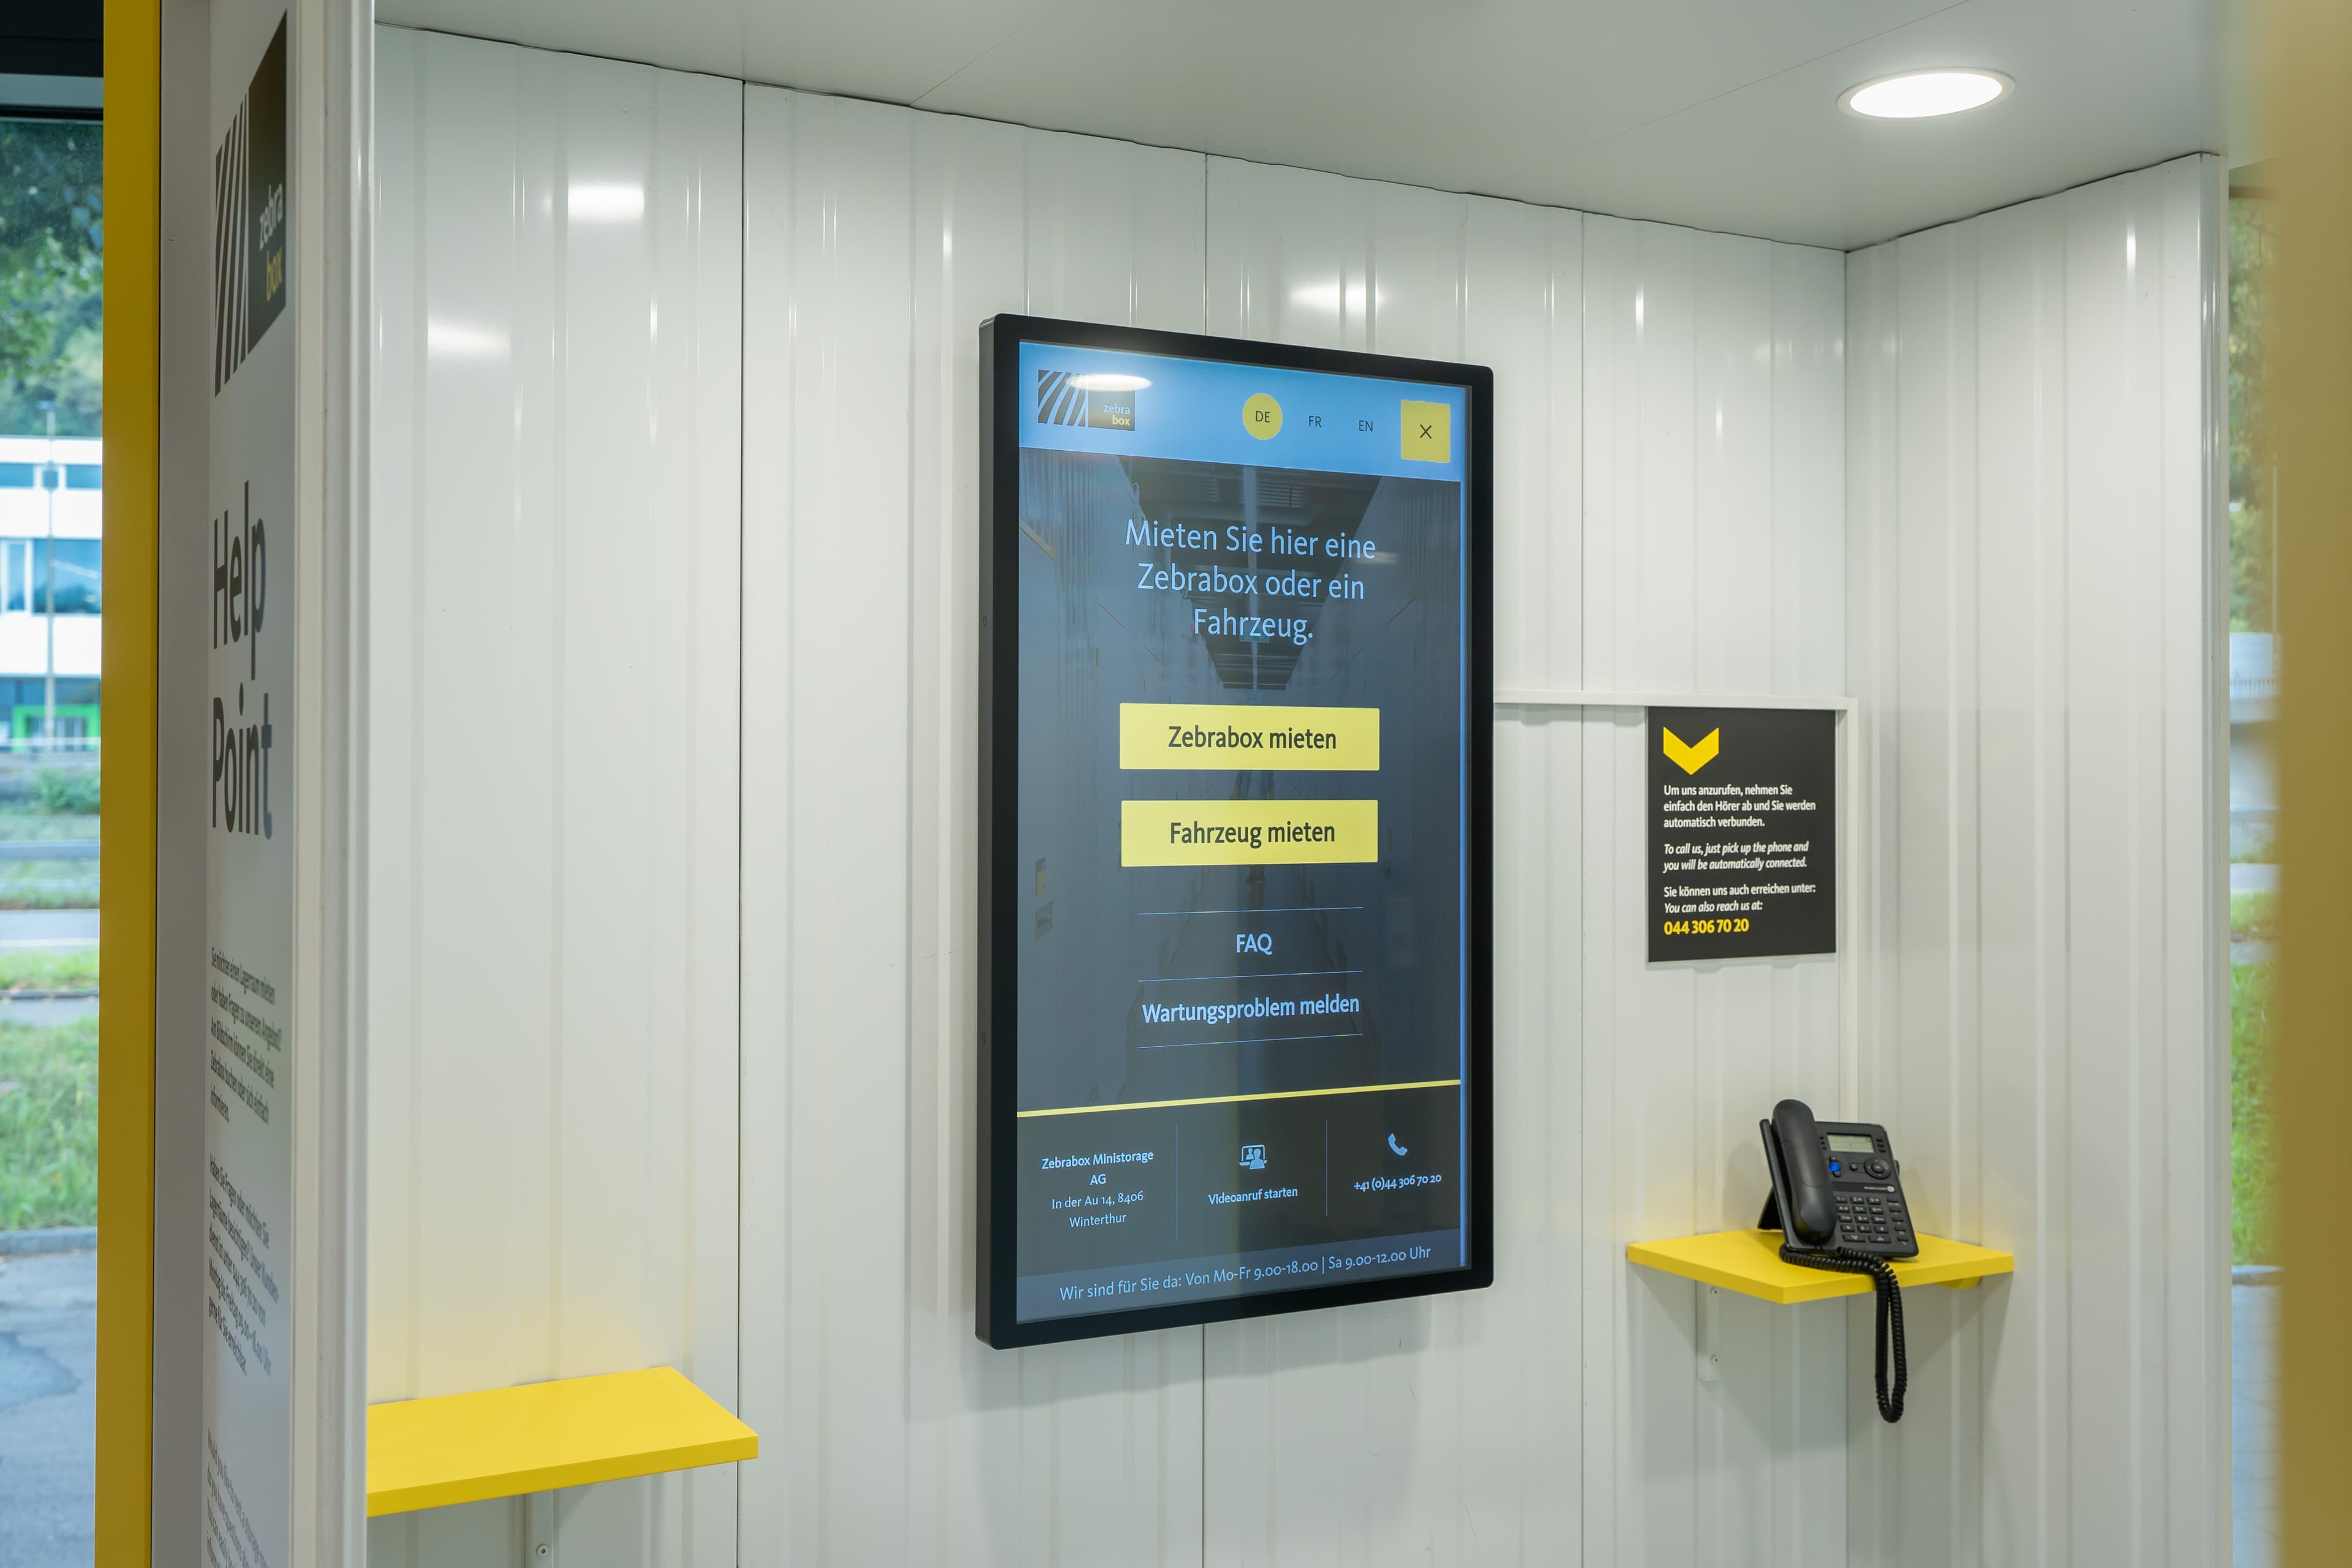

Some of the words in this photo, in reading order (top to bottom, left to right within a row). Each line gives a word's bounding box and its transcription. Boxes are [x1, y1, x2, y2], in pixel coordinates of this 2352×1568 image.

[259, 181, 283, 251] zebra
[266, 247, 282, 301] box
[1103, 403, 1131, 415] zebra
[1112, 415, 1130, 427] box
[1255, 410, 1270, 423] DE
[1309, 415, 1322, 428] FR
[1359, 420, 1373, 432] EN
[1125, 518, 1218, 550] Mieten
[1226, 526, 1263, 552] Sie
[1270, 529, 1318, 556] hier
[1325, 532, 1376, 559] eine
[213, 480, 266, 680] Help
[1137, 562, 1257, 595] Zebrabox
[1265, 570, 1321, 598] oder
[1328, 573, 1364, 600] ein
[1193, 607, 1314, 645] Fahrzeug.
[1169, 726, 1264, 749] Zebrabox
[1269, 728, 1336, 750] mieten
[213, 682, 273, 840] Point
[1664, 785, 1679, 796] Um
[1681, 786, 1697, 796] uns
[1698, 785, 1743, 797] anzurufen,
[1744, 785, 1778, 795] nehmen
[1780, 785, 1793, 795] Sie
[1664, 801, 1695, 812] einfach
[1697, 801, 1713, 812] den
[1715, 800, 1740, 812] Hörer
[1741, 801, 1752, 811] ab
[1754, 801, 1770, 811] und
[1771, 800, 1784, 810] Sie
[1785, 800, 1816, 810] werden
[1664, 817, 1716, 827] automatisch
[1717, 816, 1765, 827] verbunden.
[1170, 821, 1262, 849] Fahrzeug
[1268, 821, 1335, 843] mieten
[1664, 843, 1674, 854] To
[1675, 843, 1690, 854] call
[1692, 845, 1704, 856] us,
[1704, 842, 1721, 857] just
[1722, 842, 1739, 856] pick
[1741, 843, 1751, 856] up
[1753, 842, 1766, 853] the
[1767, 842, 1792, 855] phone
[1793, 841, 1809, 852] and
[1663, 861, 1679, 873] you
[1681, 859, 1695, 870] will
[1697, 859, 1708, 869] be
[1709, 858, 1764, 872] automatically
[1765, 858, 1807, 868] connected.
[1664, 886, 1677, 897] Sie
[1679, 885, 1710, 897] können
[1713, 886, 1727, 896] uns
[1729, 885, 1749, 895] auch
[1751, 883, 1790, 894] erreichen
[1791, 883, 1816, 894] unter:
[1664, 903, 1680, 913] You
[1681, 903, 1696, 913] can
[1698, 902, 1715, 912] also
[1716, 901, 1739, 911] reach
[1741, 902, 1750, 911] us
[1752, 900, 1763, 911] at:
[1664, 921, 1689, 935] 044
[1692, 920, 1715, 934] 306
[1717, 919, 1731, 933] 70
[1733, 919, 1749, 932] 20
[1235, 934, 1273, 956] FAQ
[1142, 999, 1295, 1025] Wartungsproblem
[1300, 993, 1360, 1016] melden
[211, 1049, 225, 1081] Zebrabox
[1041, 1153, 1090, 1170] Zebrabox
[1092, 1148, 1154, 1166] Ministorage
[1090, 1173, 1107, 1186] AG
[1354, 1180, 1370, 1192] +41
[1371, 1176, 1396, 1191] (0)44
[1398, 1174, 1415, 1189] 306
[1417, 1174, 1429, 1187] 70
[1430, 1174, 1442, 1185] 20
[1052, 1198, 1061, 1210] In
[1064, 1195, 1082, 1208] der
[1084, 1194, 1099, 1207] Au
[1101, 1194, 1115, 1208] 14,
[1117, 1191, 1144, 1207] 8406
[1208, 1189, 1262, 1205] Videoanruf
[1264, 1186, 1298, 1200] starten
[1069, 1212, 1126, 1227] Winterthur
[1060, 1285, 1084, 1302] Wir
[1087, 1282, 1114, 1298] sind
[1117, 1279, 1137, 1295] für
[1140, 1276, 1160, 1292] Sie
[1163, 1273, 1182, 1289] da:
[1185, 1271, 1210, 1286] Von
[1213, 1265, 1251, 1284] Mo-Fr
[1254, 1259, 1318, 1281] 9.00-18.00
[1329, 1256, 1343, 1271] Sa
[1344, 1250, 1406, 1272] 9.00-12.00
[1409, 1245, 1431, 1261] Uhr
